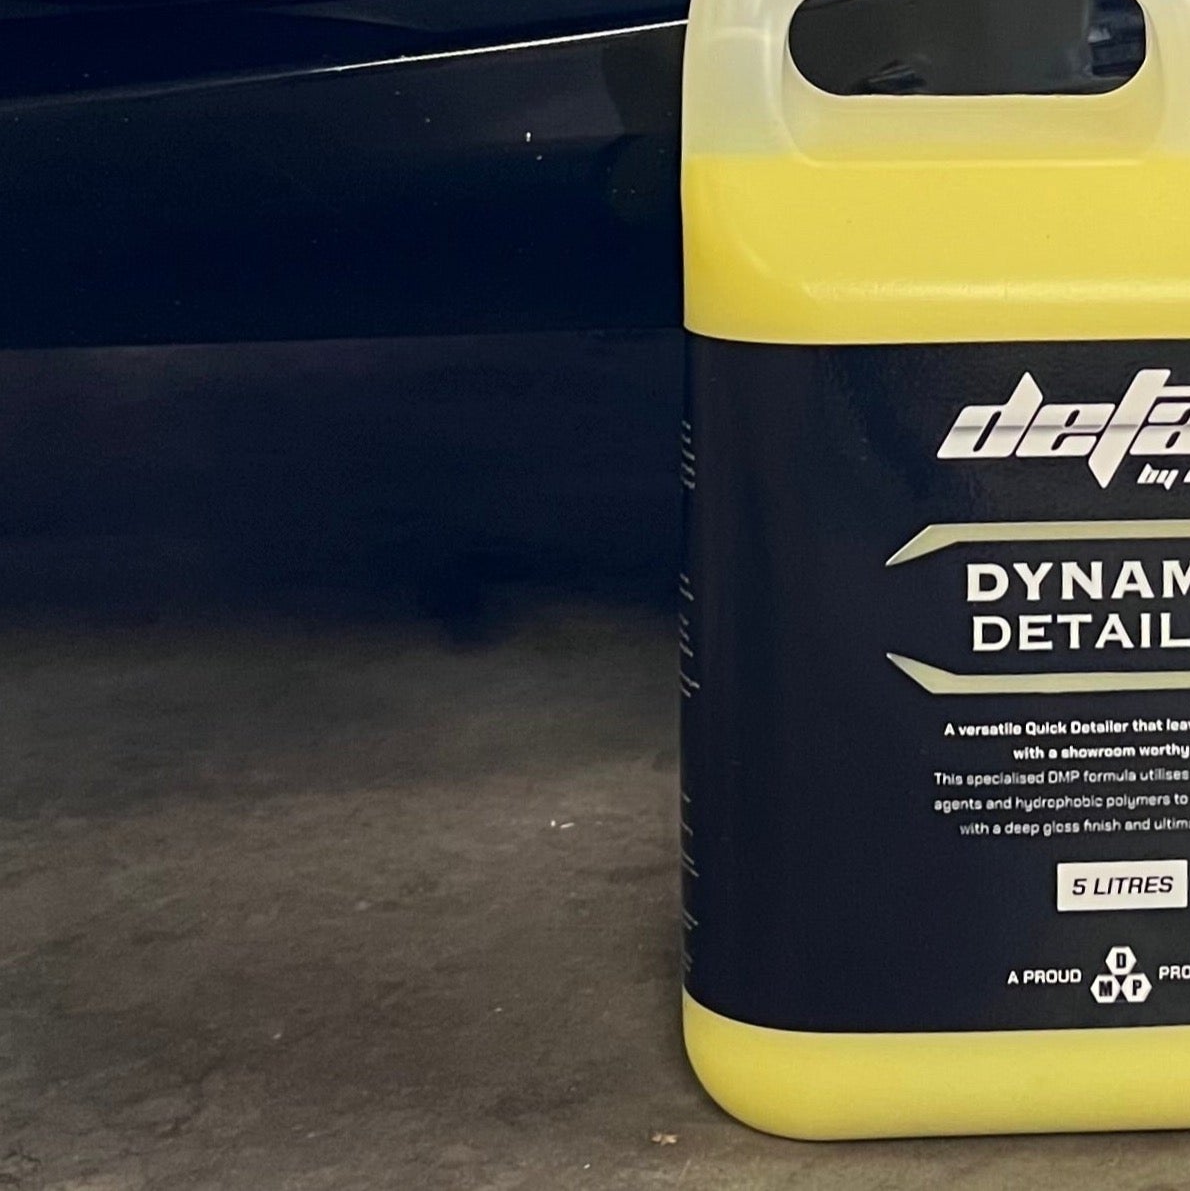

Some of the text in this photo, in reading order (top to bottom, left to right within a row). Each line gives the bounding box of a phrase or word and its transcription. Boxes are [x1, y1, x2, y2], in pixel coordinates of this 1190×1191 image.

[1136, 462, 1178, 490] by
[944, 723, 955, 735] A
[959, 723, 1021, 735] versatile
[1026, 722, 1067, 736] Quick
[1071, 720, 1129, 734] Detailer
[1132, 719, 1162, 732] that
[1014, 746, 1044, 759] with
[1049, 749, 1057, 759] a
[1061, 746, 1135, 758] showroom
[1139, 743, 1189, 758] worthy
[934, 773, 963, 785] This
[967, 771, 1044, 787] specialised
[1048, 770, 1079, 783] DMP
[1084, 769, 1136, 782] formula
[1140, 769, 1189, 781] utilises
[935, 799, 982, 813] agents
[986, 797, 1012, 809] and
[1016, 795, 1103, 812] hydrophobic
[1106, 794, 1170, 809] polymers
[1174, 794, 1188, 805] to
[960, 823, 989, 834] with
[993, 824, 1001, 834] a
[1005, 822, 1039, 836] deep
[1043, 821, 1079, 836] gloss
[1084, 819, 1121, 831] finish
[1125, 818, 1150, 830] and
[1072, 876, 1174, 895] 5 LITRES
[1008, 969, 1081, 984] A PROUD
